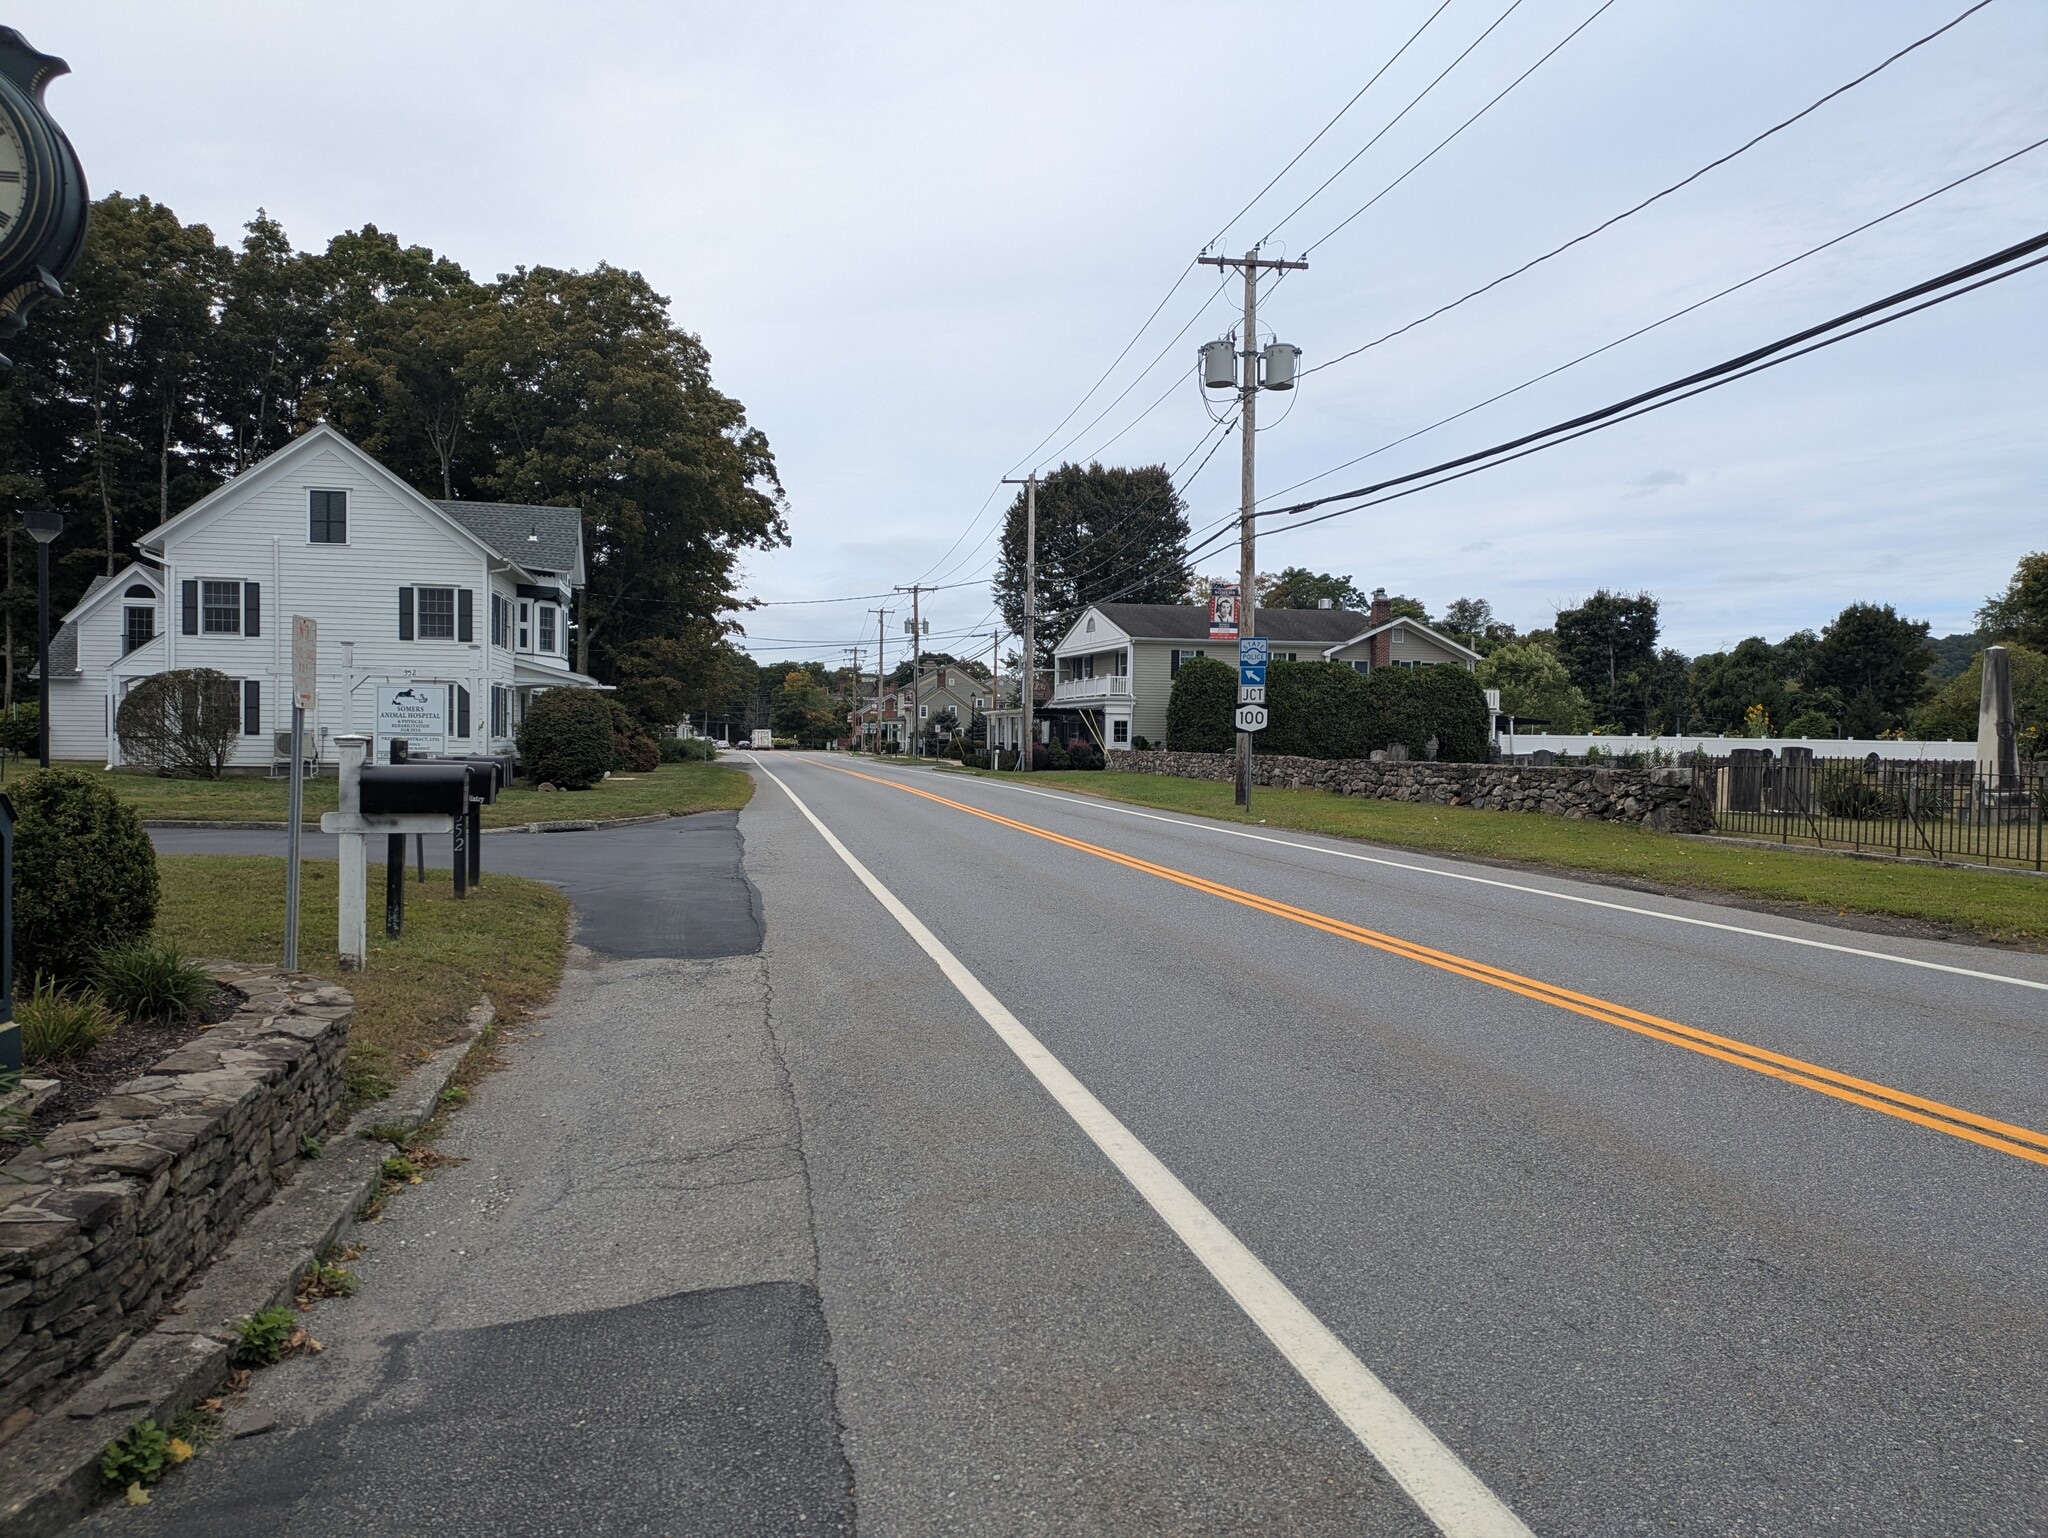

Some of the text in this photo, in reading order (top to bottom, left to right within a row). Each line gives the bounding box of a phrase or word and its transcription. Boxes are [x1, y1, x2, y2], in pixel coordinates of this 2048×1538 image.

[1243, 641, 1265, 650] STATE
[1243, 688, 1263, 700] JCT
[1240, 711, 1264, 724] 100
